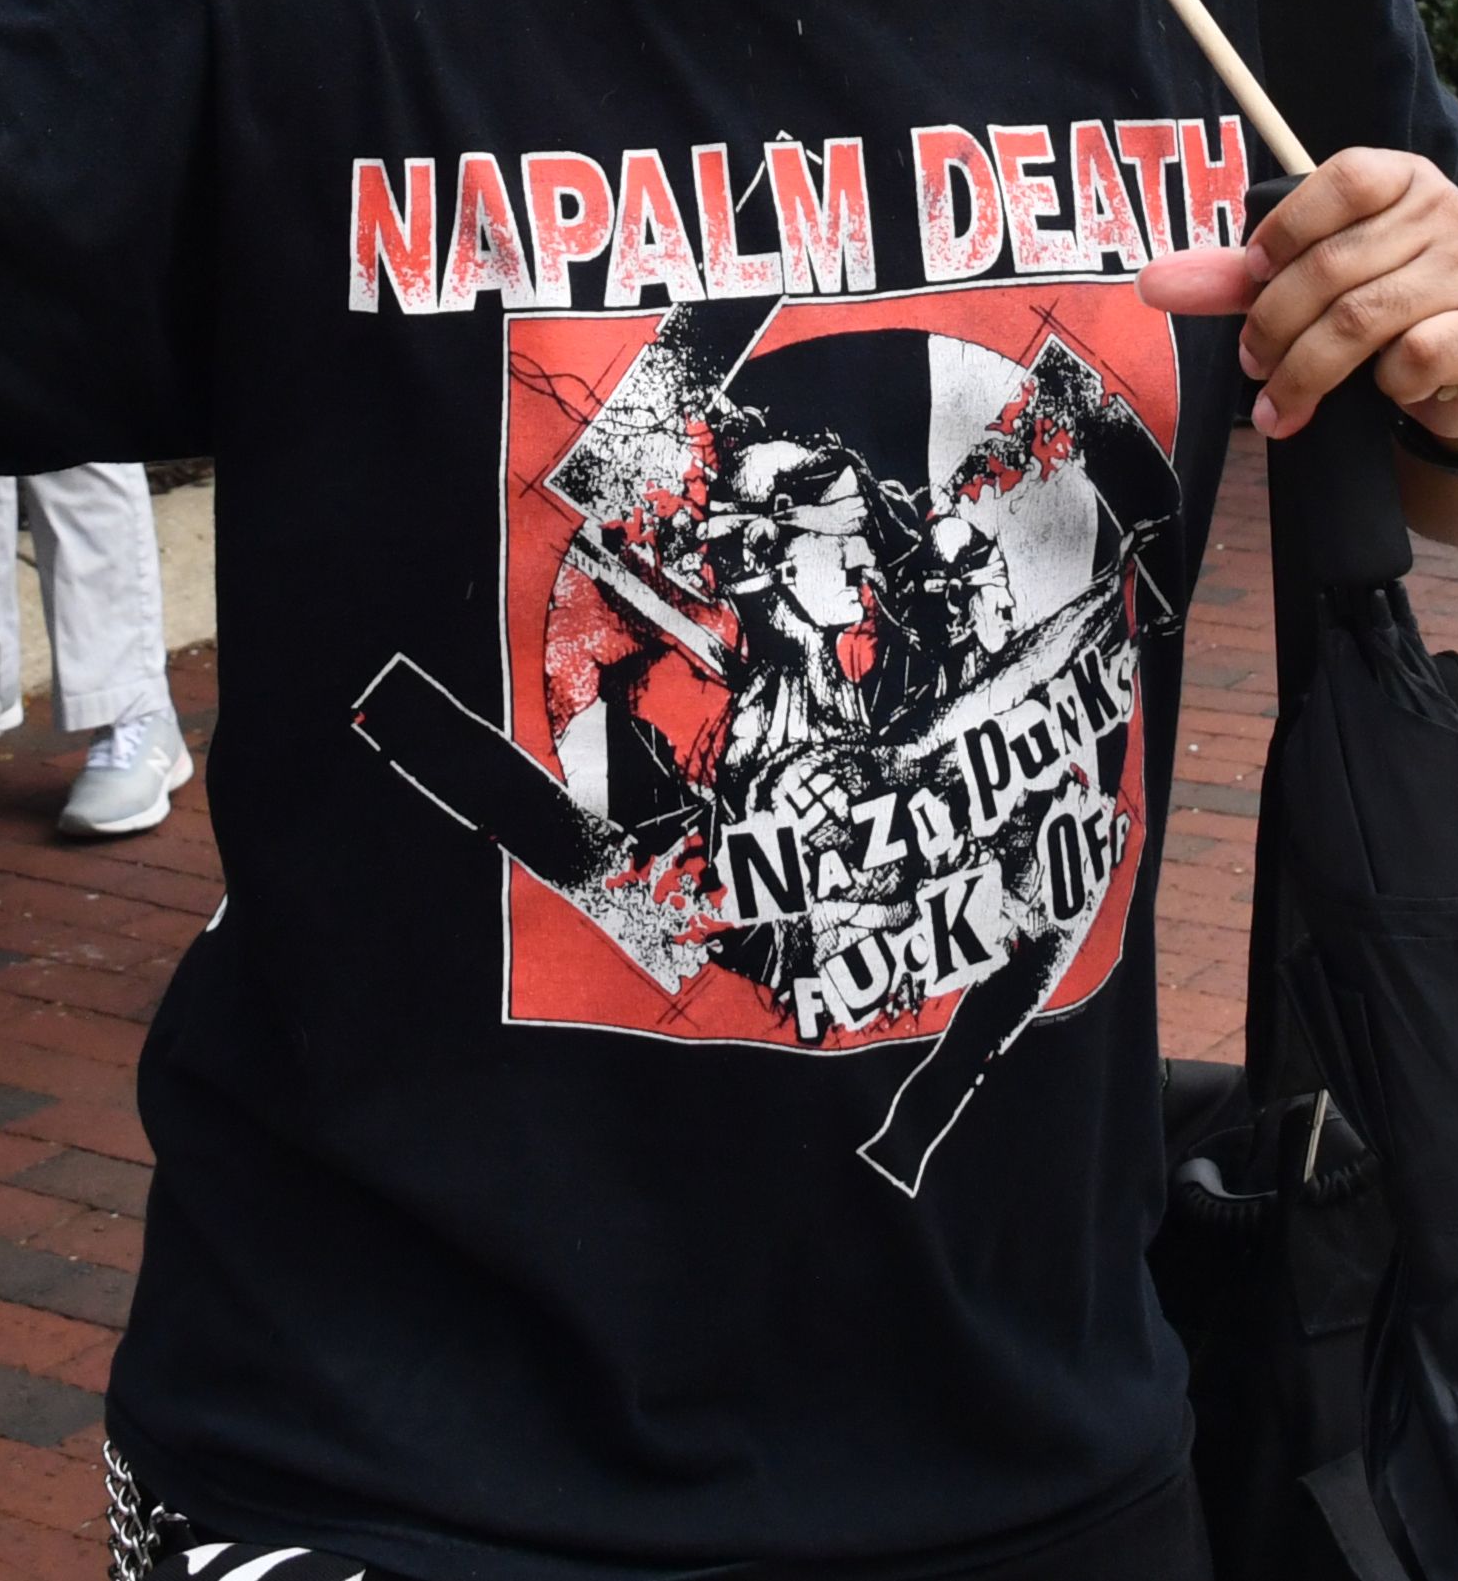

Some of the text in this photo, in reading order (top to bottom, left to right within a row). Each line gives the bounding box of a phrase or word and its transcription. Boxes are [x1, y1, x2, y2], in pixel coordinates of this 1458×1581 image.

[348, 115, 1251, 315] NAPALM DEATH
[1046, 808, 1132, 921] OFF
